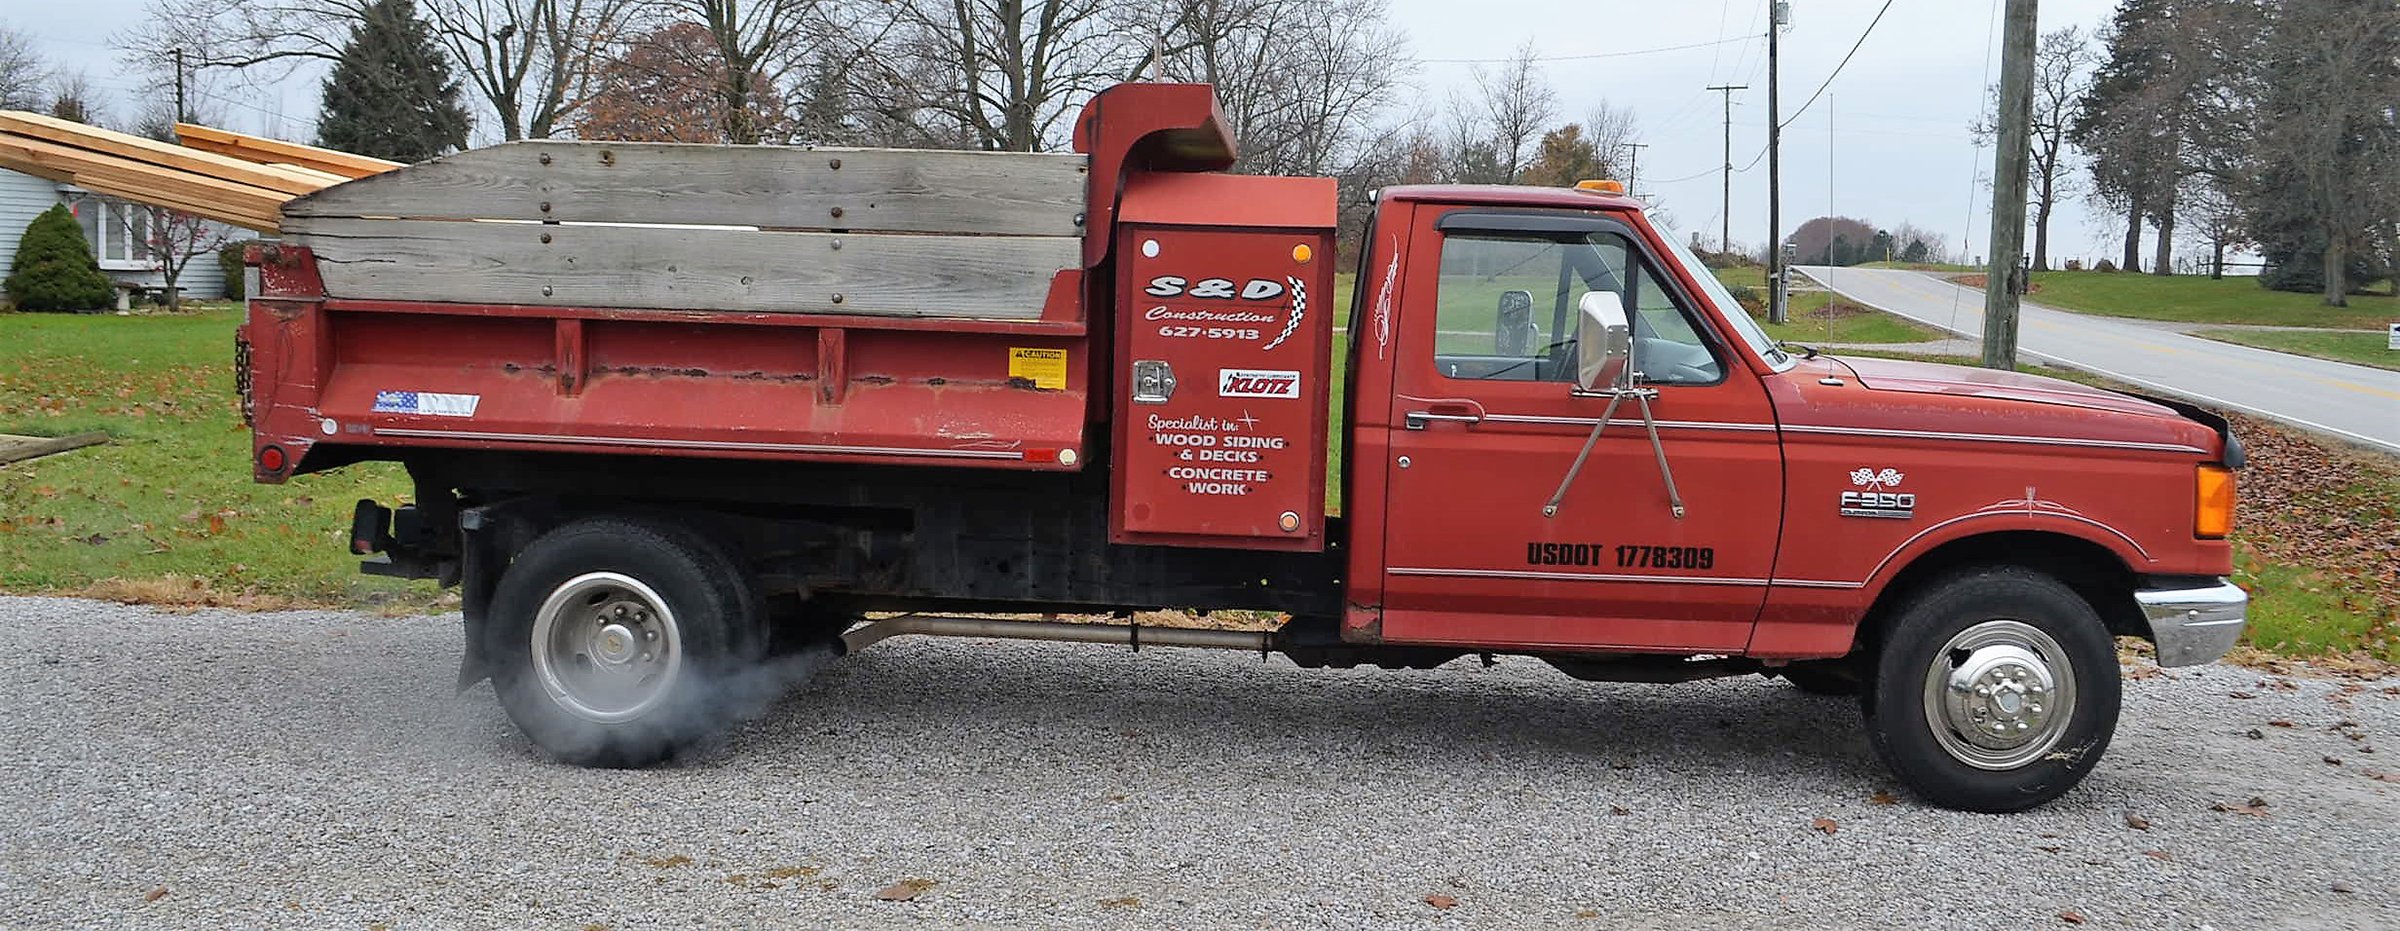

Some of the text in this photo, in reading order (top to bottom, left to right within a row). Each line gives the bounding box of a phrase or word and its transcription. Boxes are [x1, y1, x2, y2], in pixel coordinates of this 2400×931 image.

[1145, 305, 1275, 323] Construction
[1024, 350, 1062, 359] CAUTION
[1227, 377, 1296, 394] KLOTZ
[1148, 414, 1218, 432] Specialist
[1155, 433, 1284, 449] WOOD SIDING
[1180, 449, 1258, 463] & DECKS
[1169, 467, 1268, 482] CONCRETE
[1189, 483, 1247, 495] WORK
[1527, 542, 1714, 569] USDOT 1778309
